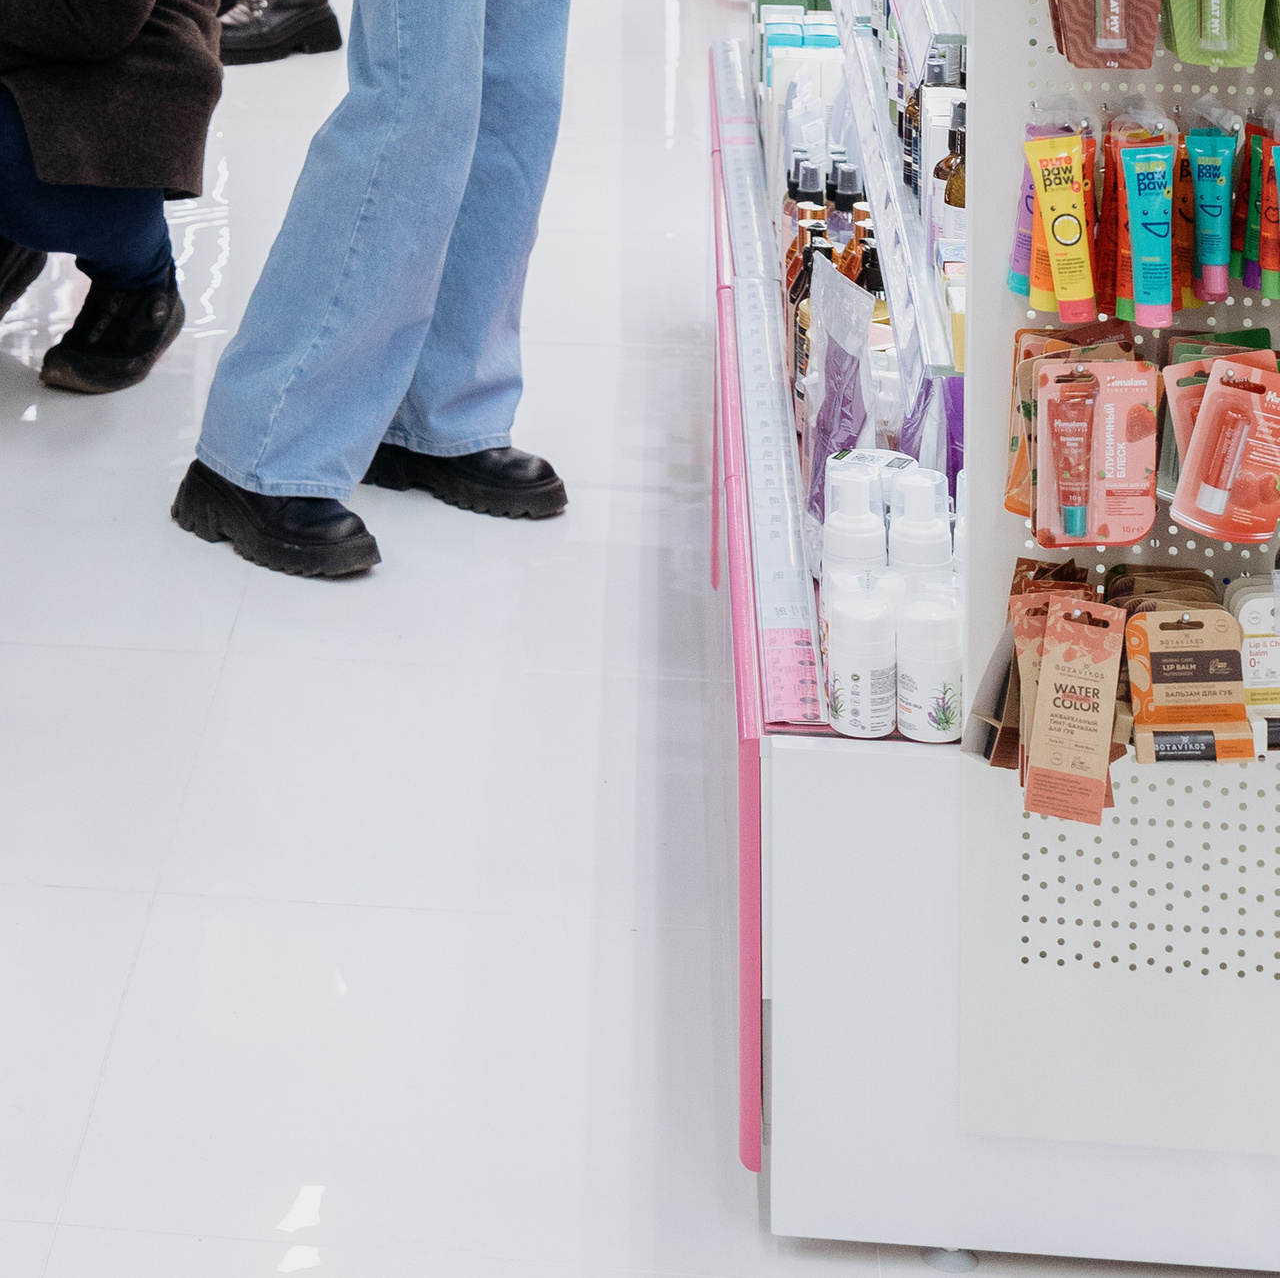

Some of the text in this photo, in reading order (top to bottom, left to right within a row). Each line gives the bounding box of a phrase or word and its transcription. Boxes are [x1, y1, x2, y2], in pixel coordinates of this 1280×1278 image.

[1110, 15, 1119, 33] MY
[1211, 18, 1219, 35] MY
[1039, 156, 1073, 170] pure
[1135, 161, 1166, 174] pure
[1197, 157, 1222, 166] pure
[1042, 165, 1073, 181] paw
[1197, 164, 1220, 174] paw
[1198, 171, 1220, 181] paw
[1044, 175, 1074, 192] paw
[1137, 171, 1166, 184] paw
[1138, 181, 1167, 196] paw
[1107, 376, 1147, 387] Himalaya
[1054, 419, 1087, 429] Himalaya
[1104, 403, 1115, 478] КЛУБНИЧНЫЙ
[1117, 442, 1125, 478] БЛЕСК
[1055, 665, 1105, 679] BOTAVIKOS
[1054, 683, 1100, 699] WATER
[1053, 697, 1100, 713] COLOR
[1049, 719, 1098, 733] ТИНТ-БАЛЬЗАМ
[1050, 713, 1098, 725] АКВАРЕЛЬНЫЙ
[1049, 727, 1062, 735] ДЛЯ
